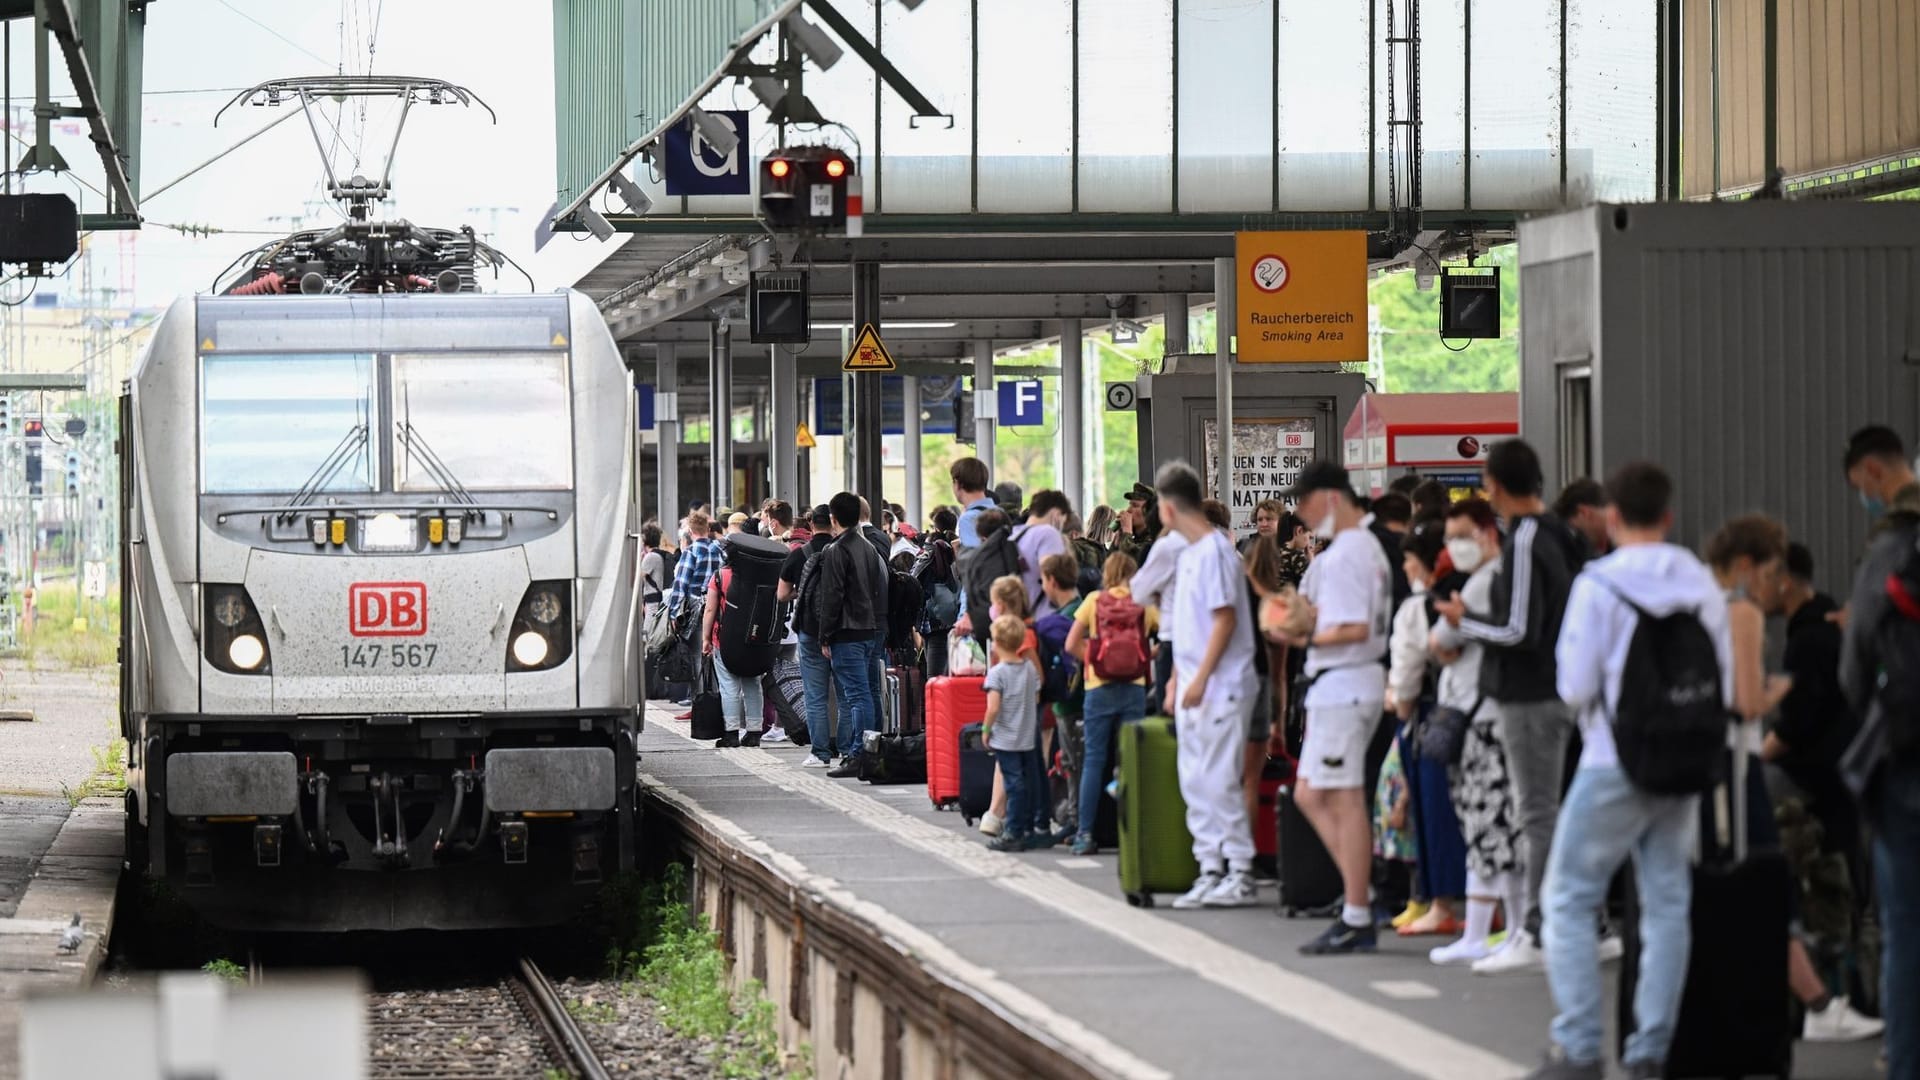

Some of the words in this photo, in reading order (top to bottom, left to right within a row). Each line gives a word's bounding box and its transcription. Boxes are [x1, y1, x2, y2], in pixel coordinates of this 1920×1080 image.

[1250, 312, 1354, 325] Raucherbereich
[1261, 330, 1312, 344] Smoking
[1316, 330, 1344, 341] Area
[1015, 381, 1037, 416] F
[1287, 436, 1300, 444] DB
[1260, 455, 1277, 469] SIE
[1283, 455, 1307, 469] SICH
[1242, 472, 1265, 486] DEN
[359, 590, 418, 628] DB
[340, 644, 383, 668] 147
[391, 644, 438, 668] 567
